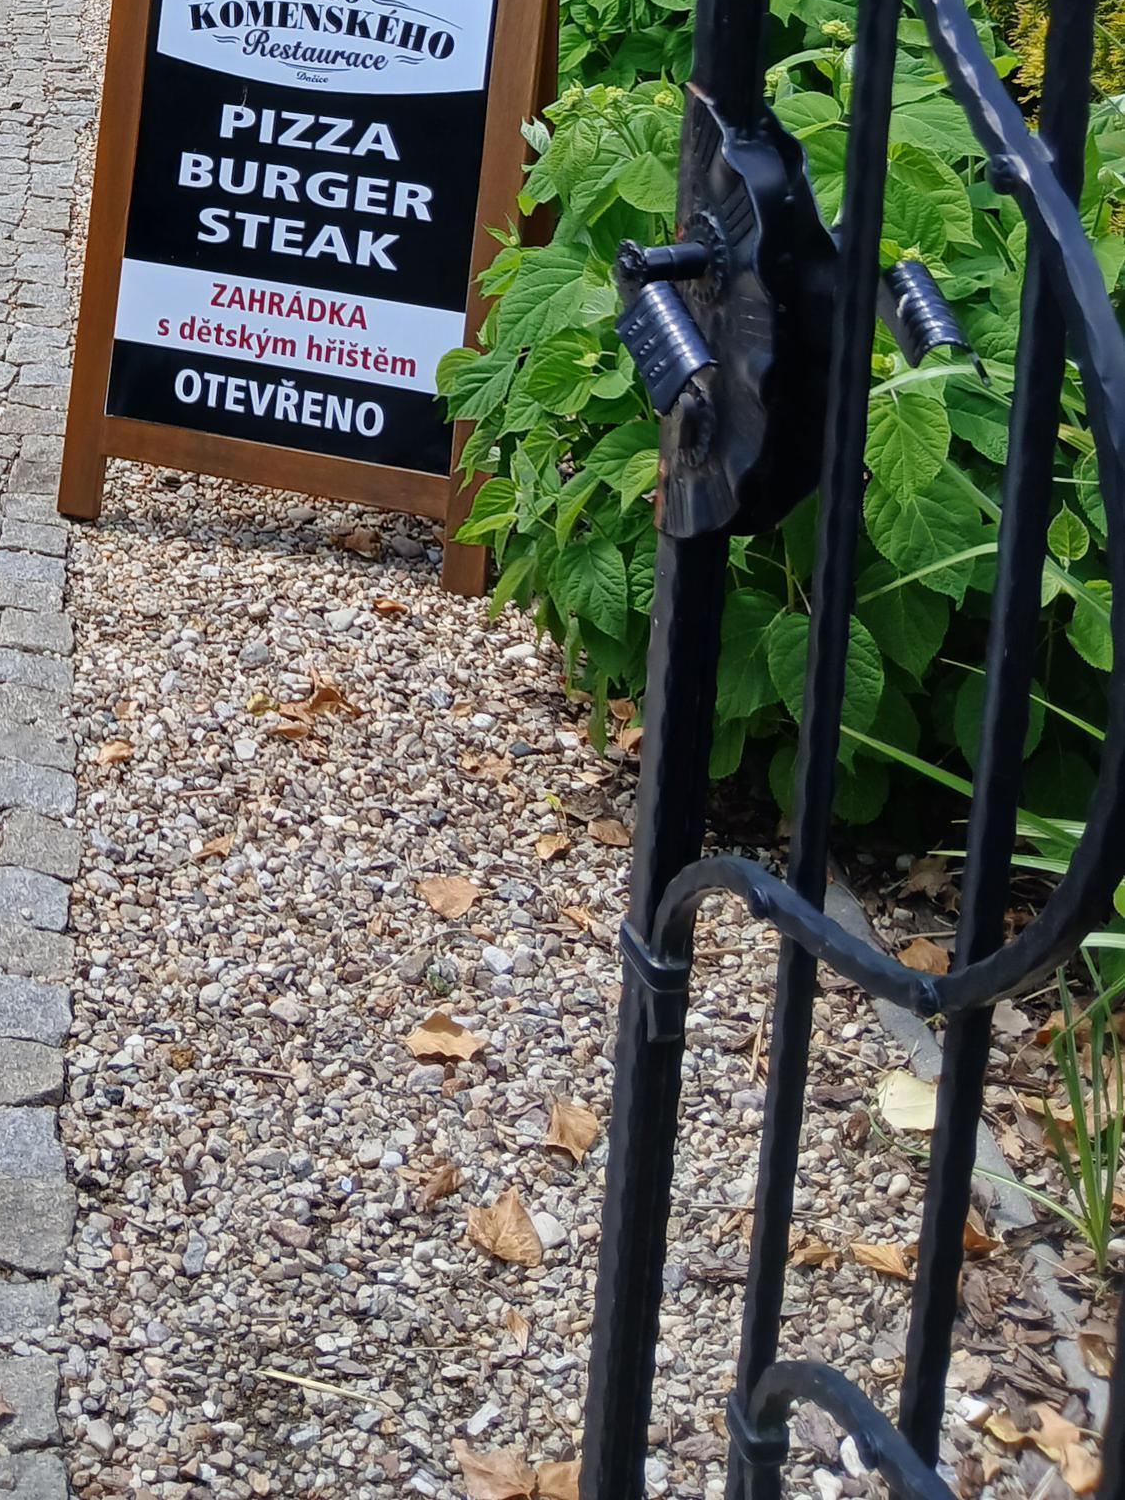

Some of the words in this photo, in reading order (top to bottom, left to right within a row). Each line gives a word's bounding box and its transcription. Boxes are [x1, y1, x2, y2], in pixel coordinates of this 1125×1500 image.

[188, 0, 455, 60] KOMENSKÉHO
[242, 28, 389, 71] Restaurace
[219, 103, 401, 161] PIZZA
[178, 151, 433, 222] BURGER
[197, 208, 399, 271] STEAK
[209, 281, 368, 331] ZAHRÁDKA
[157, 316, 171, 337] s
[178, 317, 298, 359] dětským
[305, 332, 417, 378] hřištěm
[174, 367, 385, 438] OTEVŘENO
